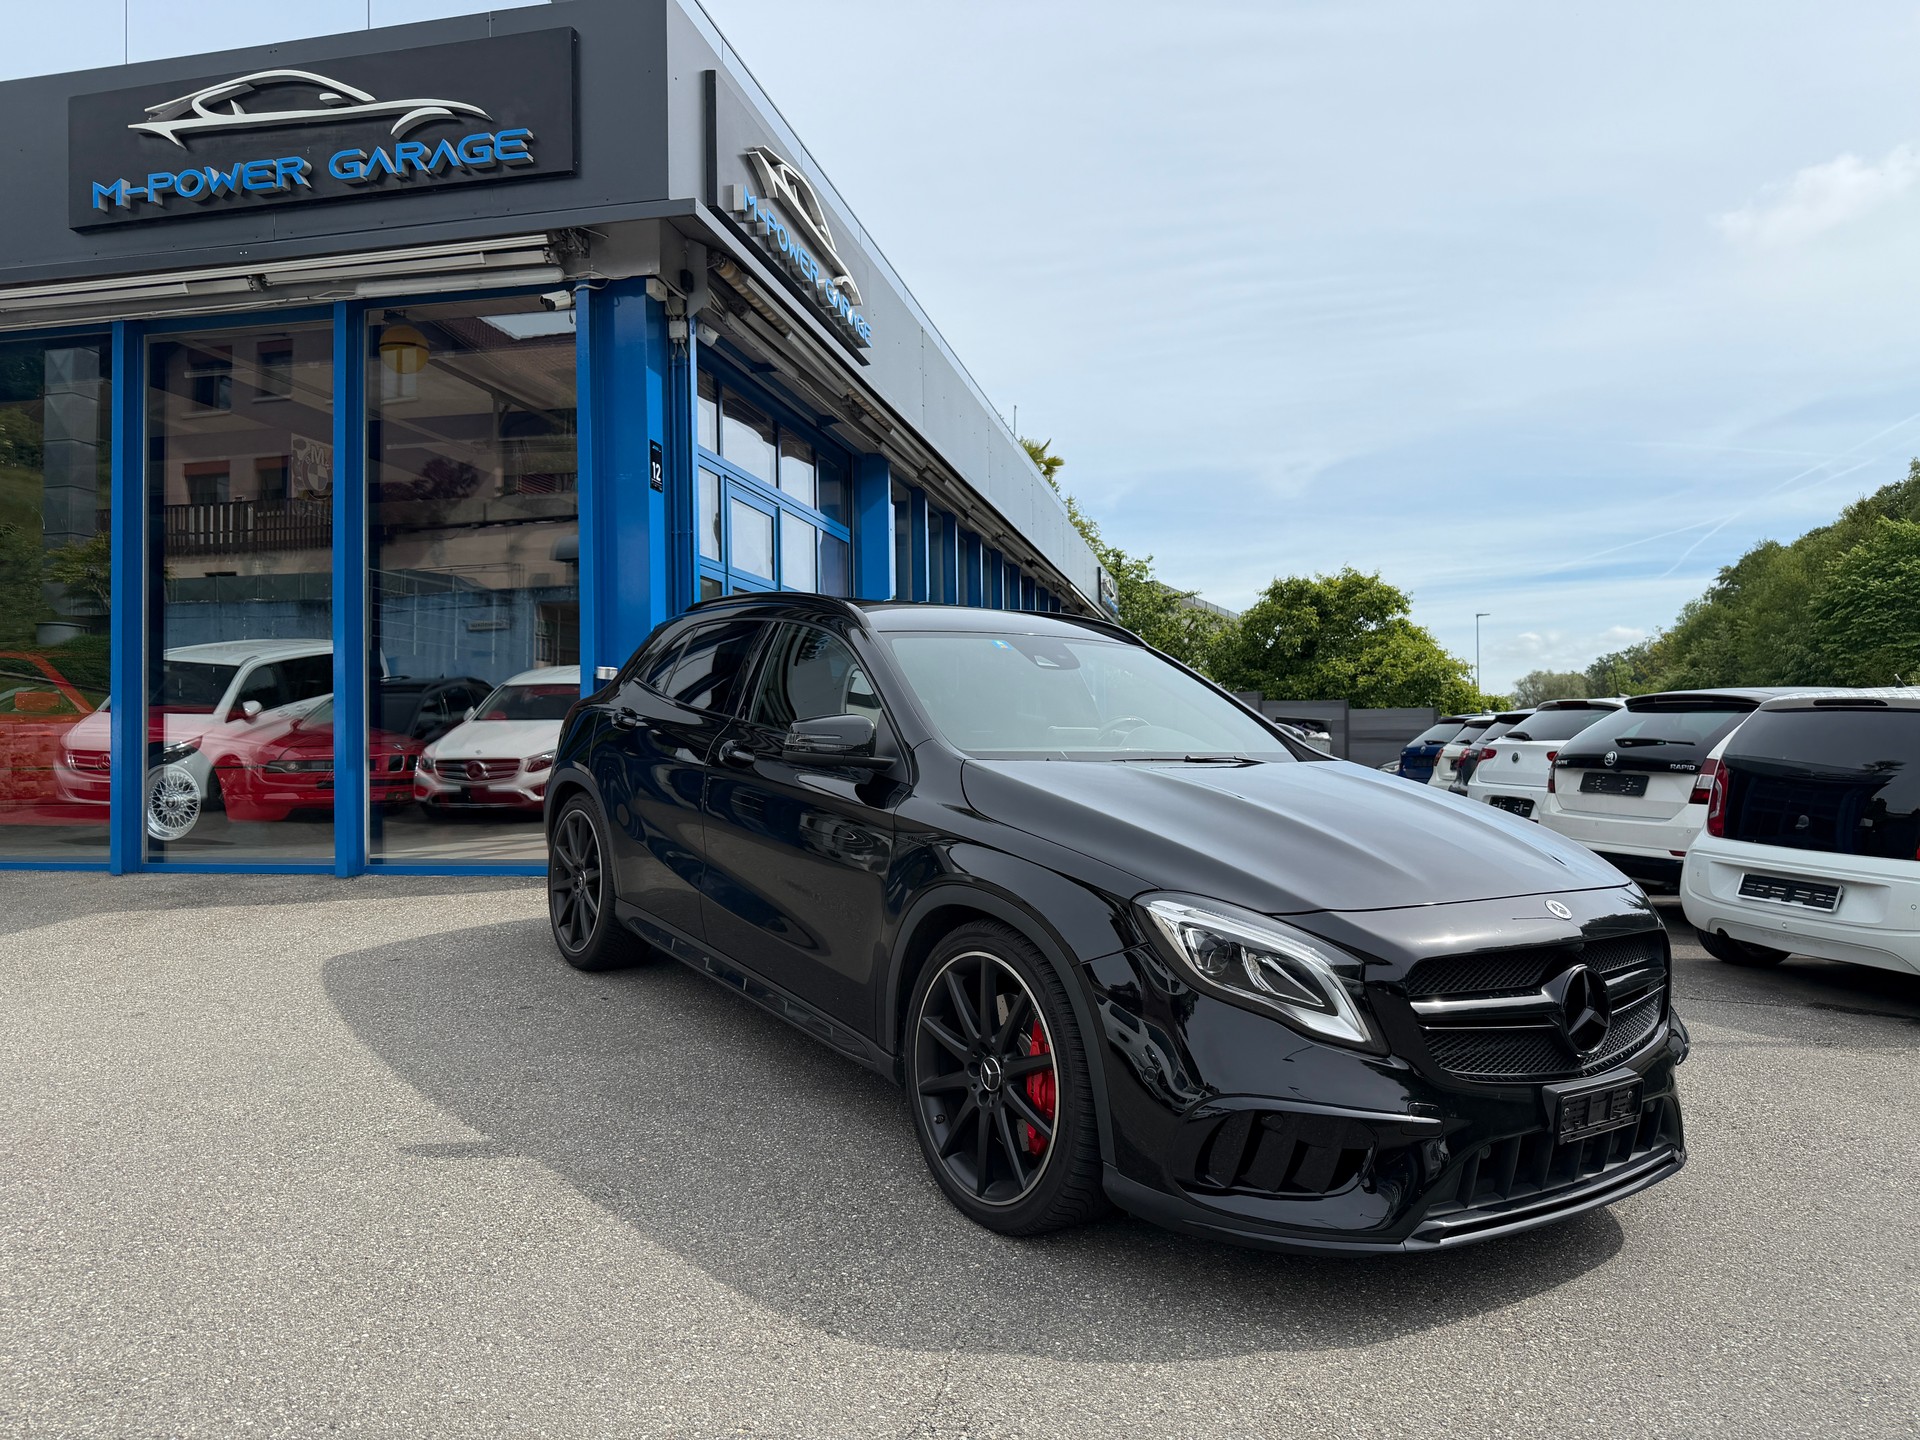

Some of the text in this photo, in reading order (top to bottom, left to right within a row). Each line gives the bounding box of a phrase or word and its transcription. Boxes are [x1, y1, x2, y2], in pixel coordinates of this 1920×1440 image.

[93, 128, 530, 209] M-POWER GARAGE
[743, 184, 872, 348] M-POWER GARAGE
[651, 461, 662, 482] 12
[1669, 763, 1696, 771] RAPID
